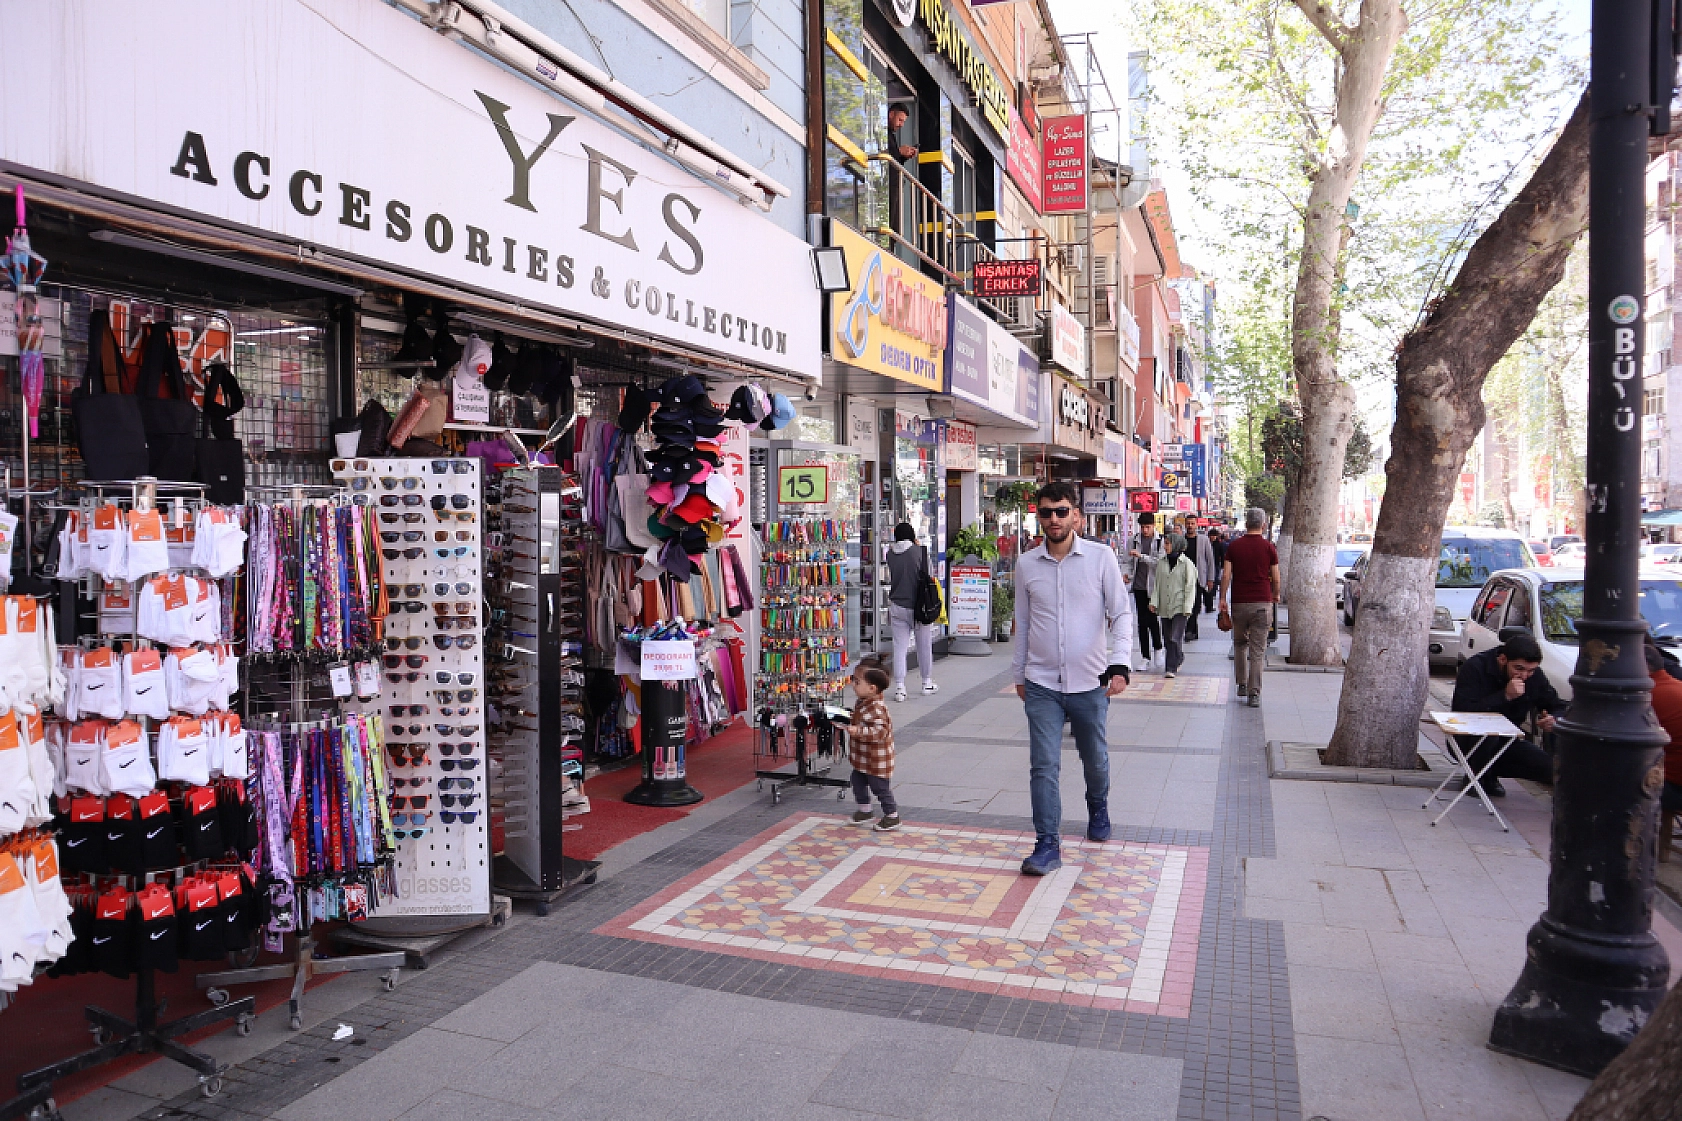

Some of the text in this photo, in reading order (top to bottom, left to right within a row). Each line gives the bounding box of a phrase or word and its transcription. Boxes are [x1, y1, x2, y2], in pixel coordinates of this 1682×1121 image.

[473, 89, 704, 276] YES
[169, 130, 788, 355] ACCESORIES & COLLECTION
[985, 278, 1029, 291] ERKEK
[785, 473, 815, 499] 15
[643, 653, 692, 661] DEODORANT
[400, 872, 472, 899] glasses
